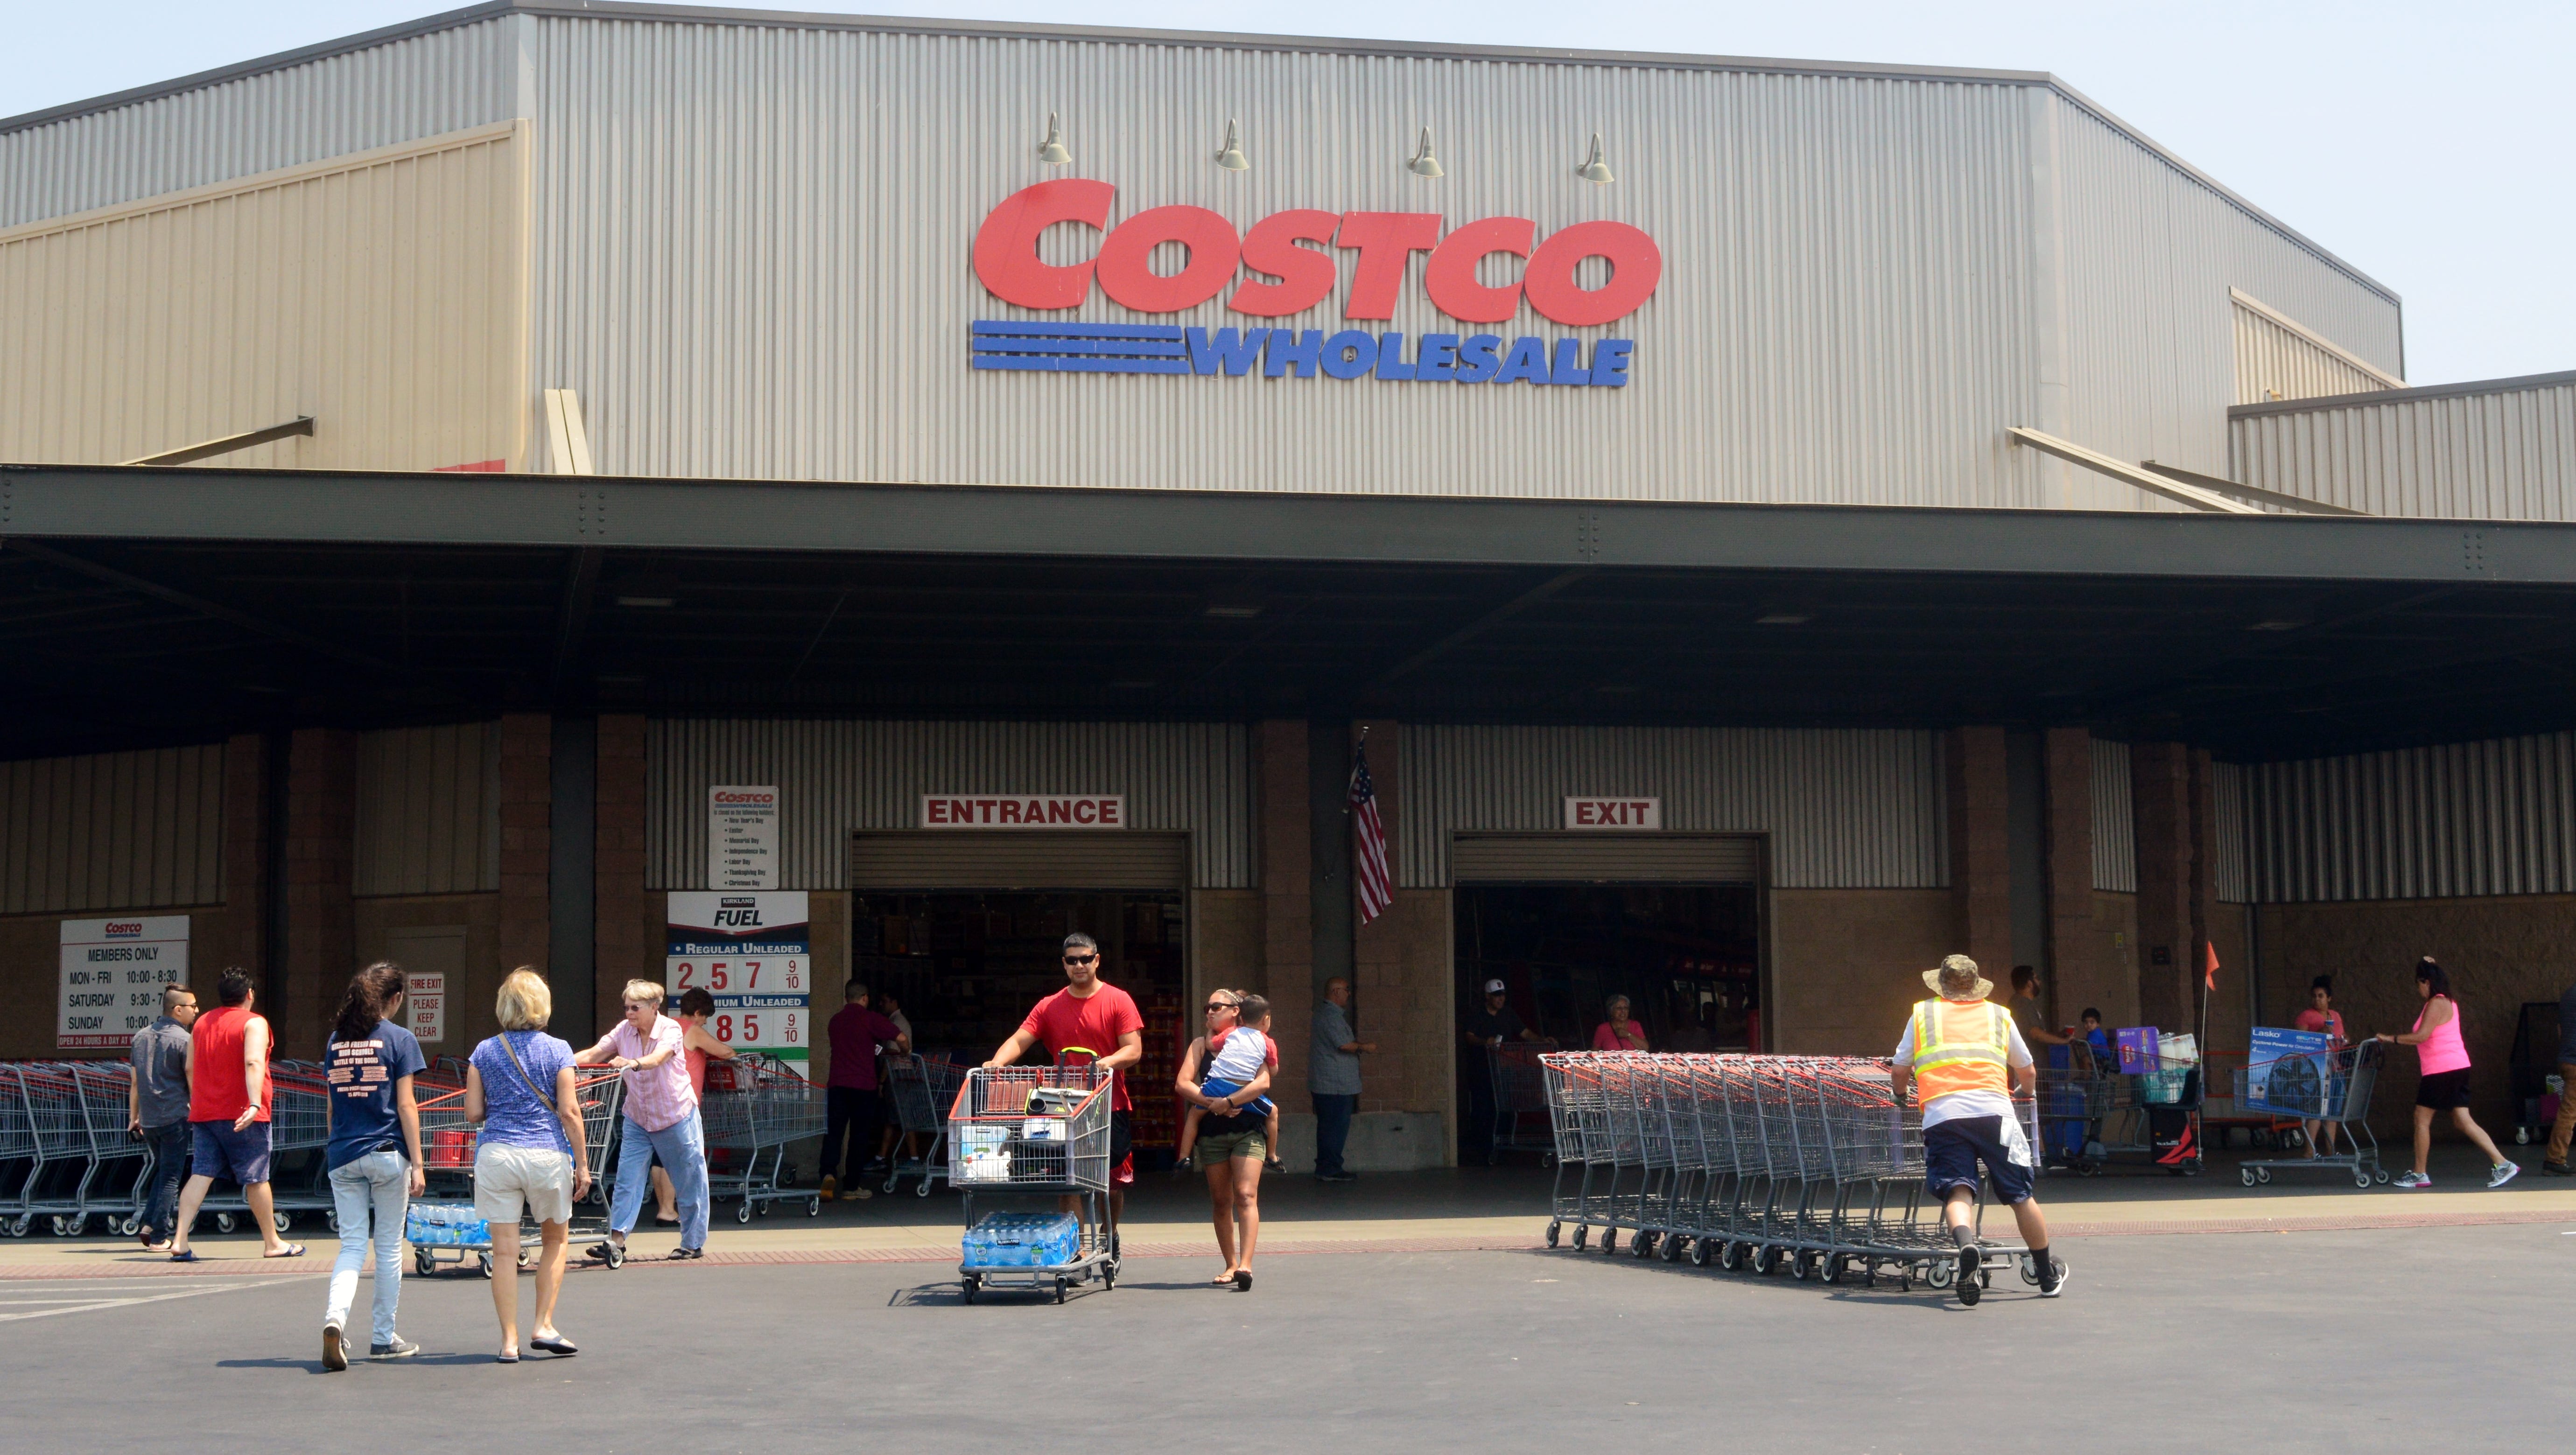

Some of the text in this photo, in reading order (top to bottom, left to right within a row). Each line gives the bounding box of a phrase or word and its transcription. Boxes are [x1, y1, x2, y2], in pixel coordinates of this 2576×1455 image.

[973, 178, 1662, 325] COSTCO
[1185, 326, 1633, 386] WHOLESALE
[715, 791, 773, 803] COSTCO
[928, 800, 1118, 824] ENTRANCE
[1576, 802, 1649, 825] EXIT
[714, 910, 763, 926] FUEL
[105, 923, 142, 933] COSTCO
[88, 947, 159, 962] MEMBERS ONLY
[686, 943, 801, 954] REGULAR UNLEADED
[70, 972, 90, 985] MON
[98, 971, 112, 984] FRI
[127, 971, 150, 983] 10:00
[158, 970, 177, 982] 8:30
[411, 979, 442, 988] FIRE EXIT
[69, 994, 114, 1007] SATURDAY
[131, 993, 150, 1006] 9:30
[413, 999, 438, 1009] PLEASE
[743, 996, 801, 1006] UNLEADED
[69, 1016, 104, 1029] SUNDAY
[126, 1016, 149, 1028] 10:00
[417, 1013, 434, 1023] KEEP
[414, 1027, 436, 1036] CLEAR
[2253, 1029, 2280, 1038] Lasko
[84, 1036, 101, 1045] HOURS
